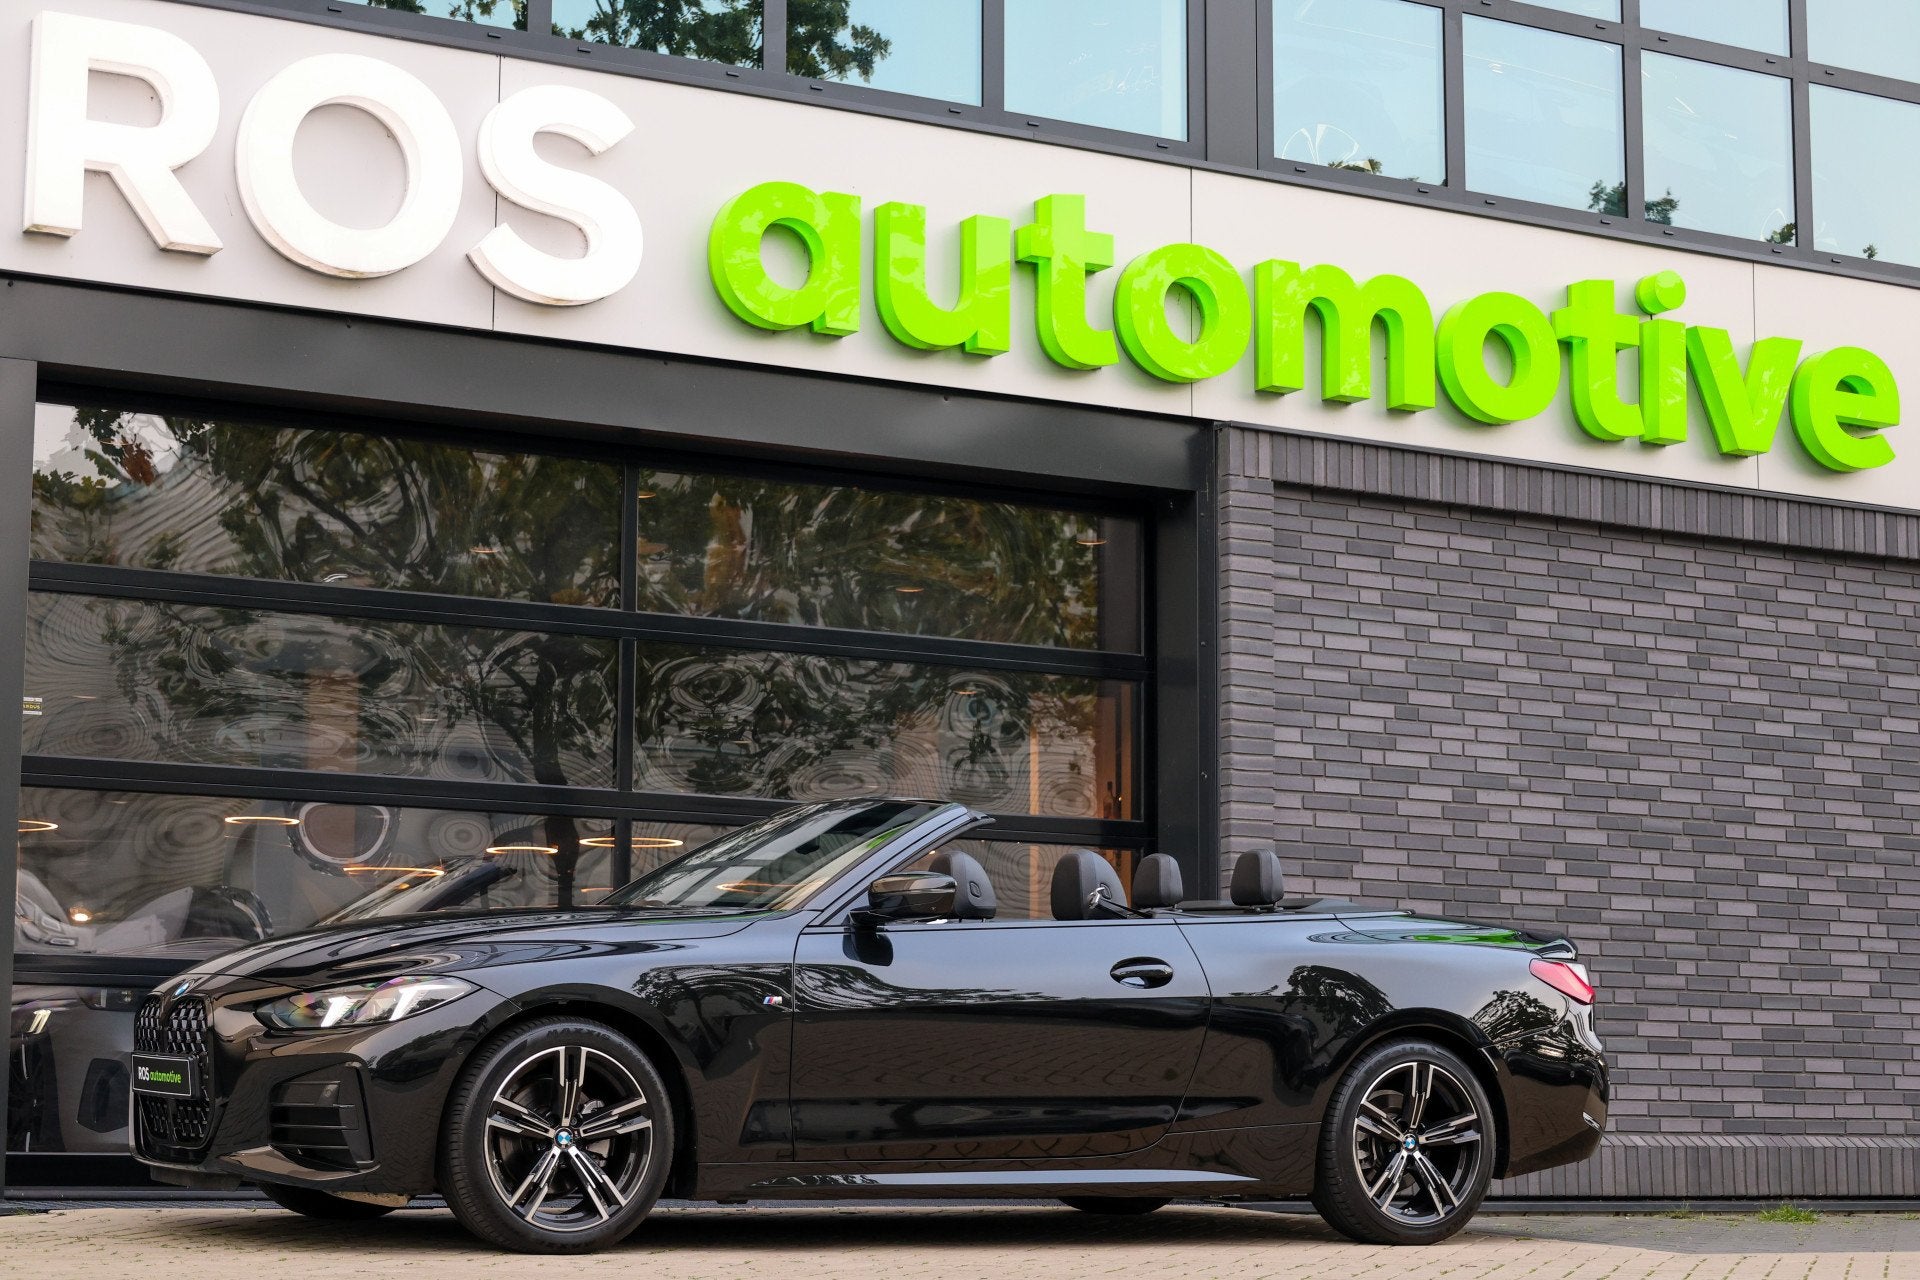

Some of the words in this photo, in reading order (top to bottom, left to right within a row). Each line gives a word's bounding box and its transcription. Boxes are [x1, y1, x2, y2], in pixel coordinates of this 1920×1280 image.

[23, 11, 644, 306] ROS
[708, 182, 1900, 471] automotive
[138, 1066, 149, 1081] ROS
[150, 1070, 181, 1083] automotive
